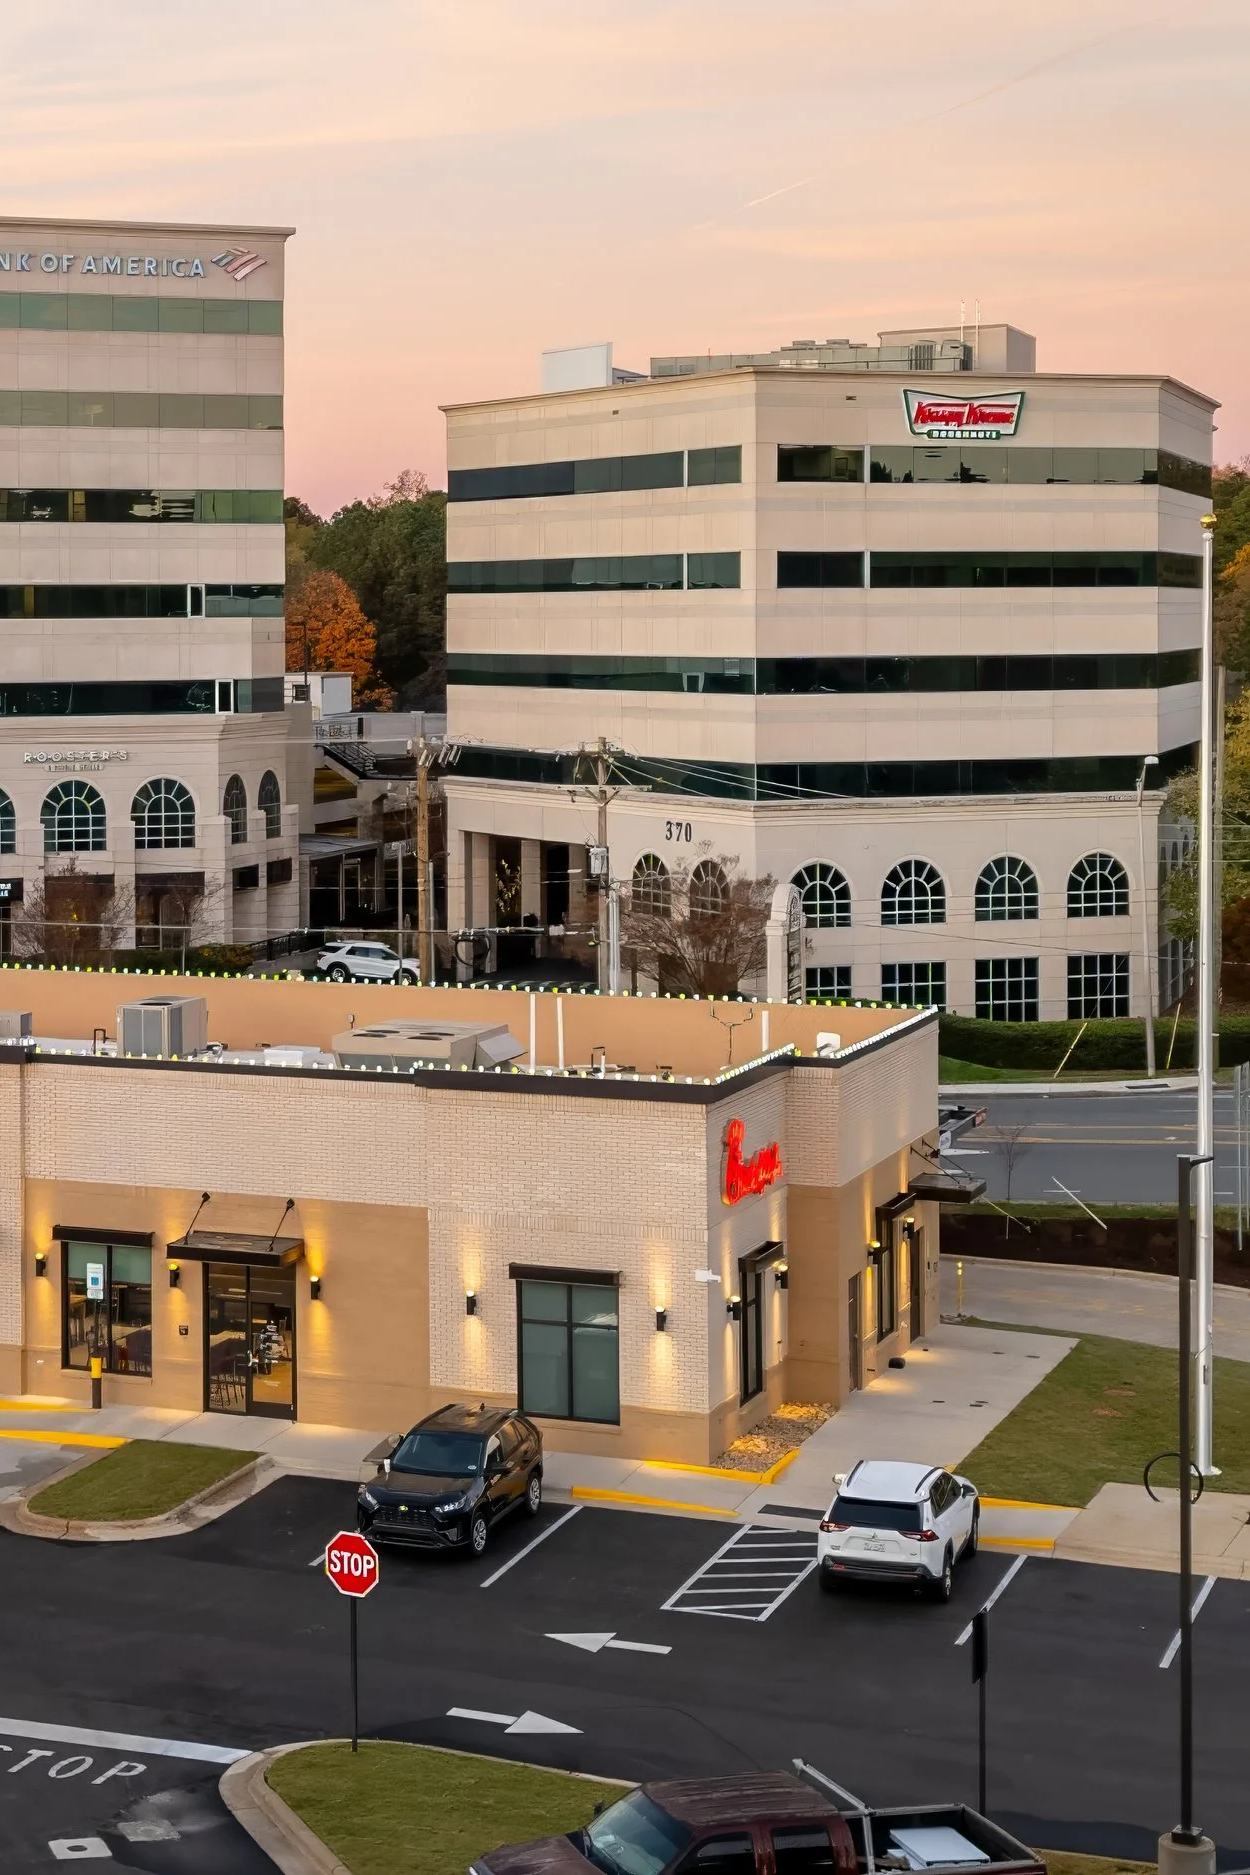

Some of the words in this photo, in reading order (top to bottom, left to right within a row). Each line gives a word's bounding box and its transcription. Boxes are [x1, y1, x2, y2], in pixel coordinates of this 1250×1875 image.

[40, 252, 74, 274] OF
[80, 254, 206, 278] AMERICA
[665, 821, 692, 842] 370
[330, 1549, 375, 1578] STOP
